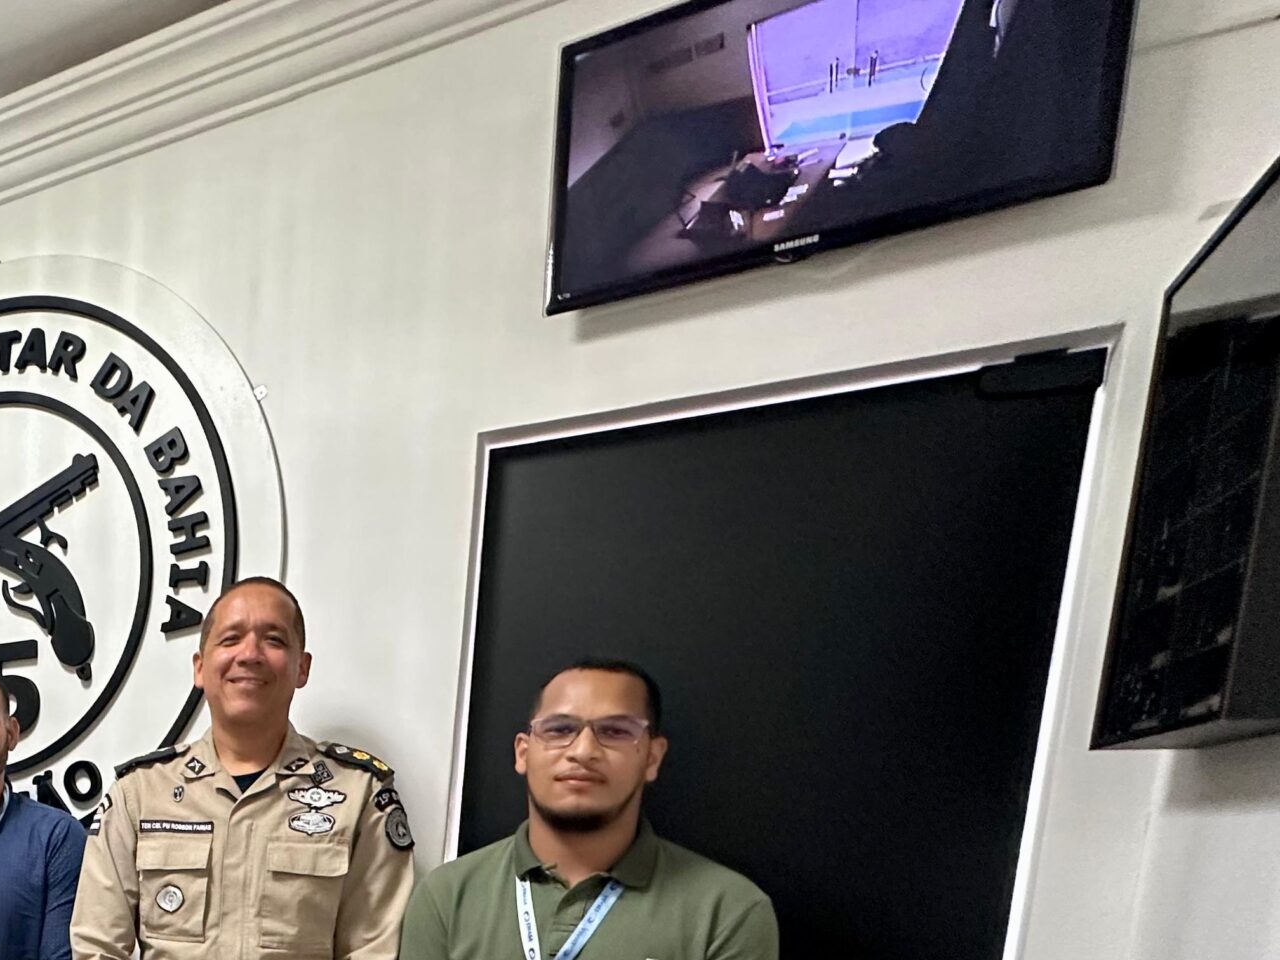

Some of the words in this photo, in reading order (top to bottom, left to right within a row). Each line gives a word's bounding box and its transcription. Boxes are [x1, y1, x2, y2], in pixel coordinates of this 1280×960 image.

[773, 234, 819, 252] SAMSUNG
[90, 352, 157, 432] DA
[144, 426, 212, 634] BAHIA
